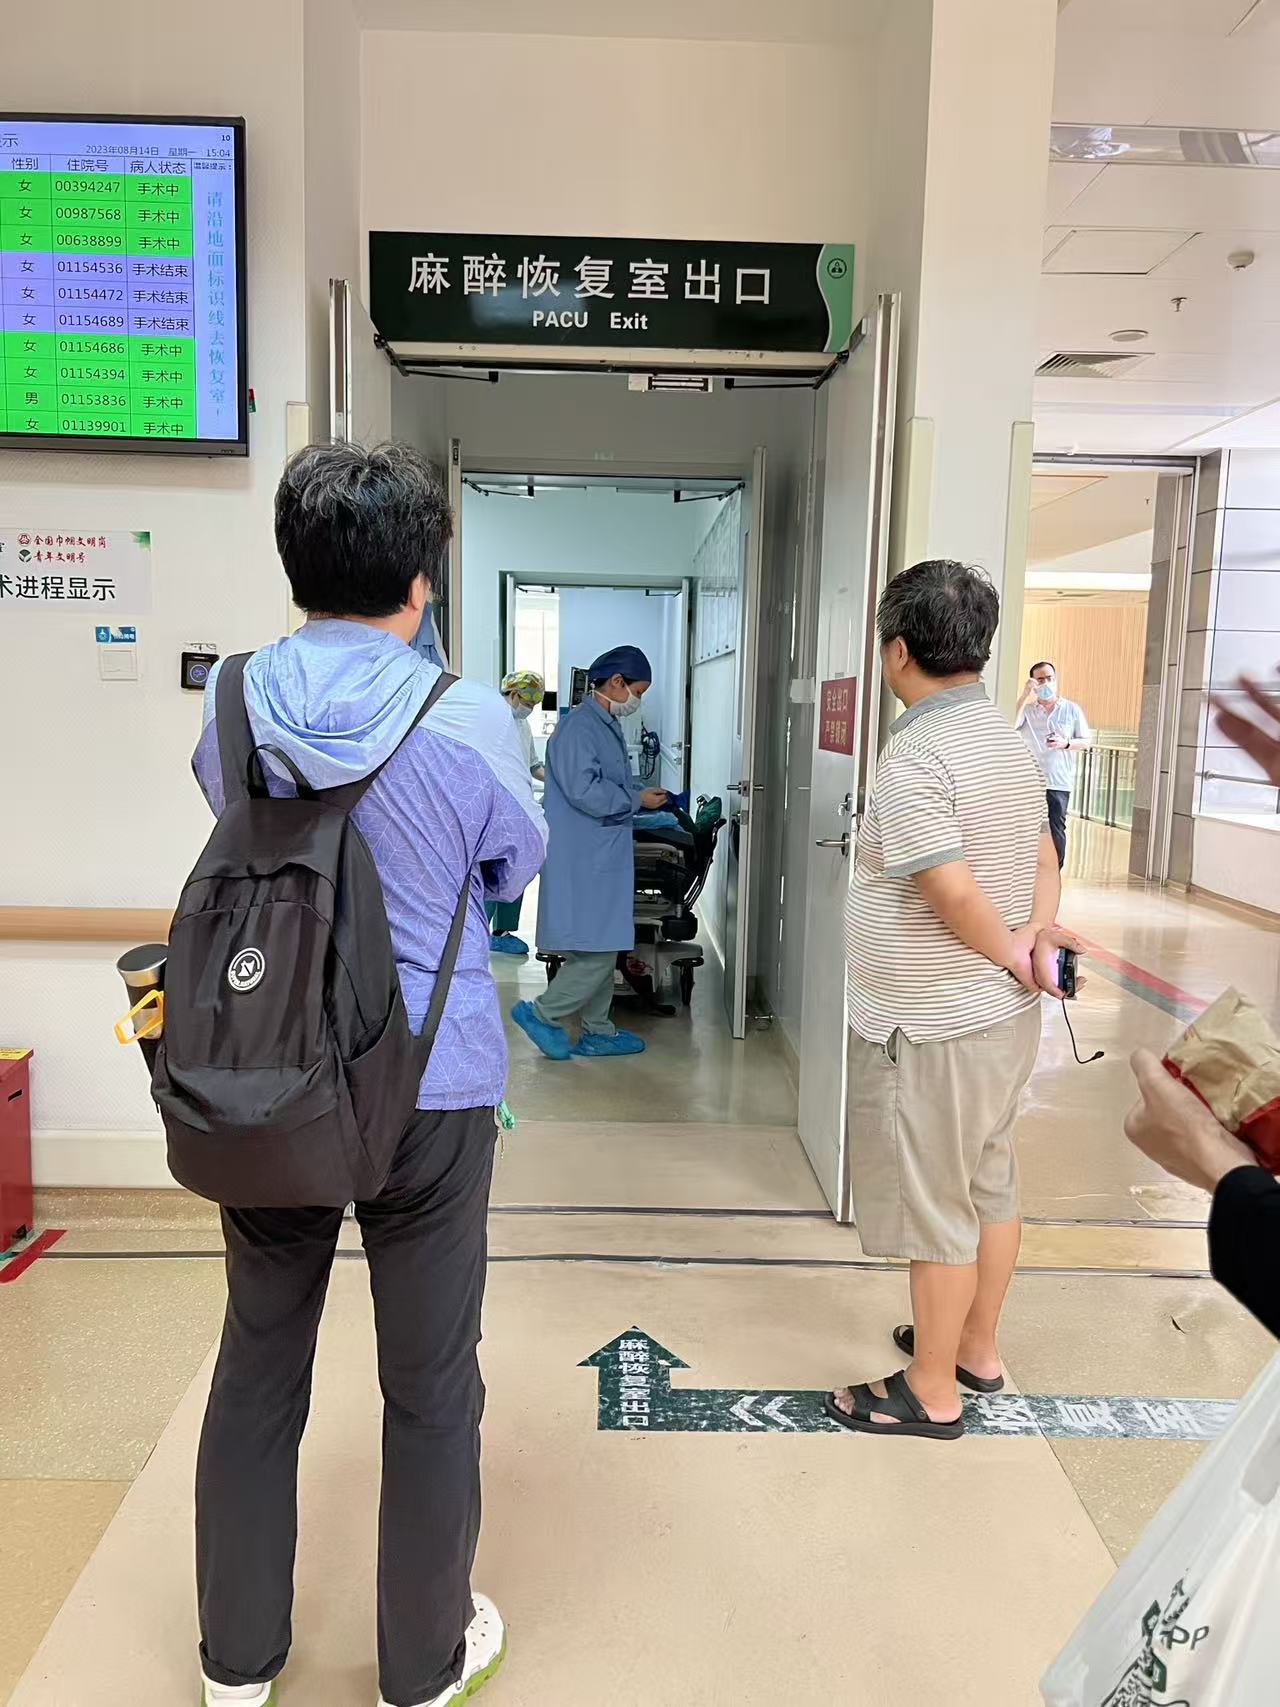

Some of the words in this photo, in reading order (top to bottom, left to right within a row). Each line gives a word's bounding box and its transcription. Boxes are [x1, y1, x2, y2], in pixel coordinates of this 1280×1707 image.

[0, 133, 19, 148] 示
[221, 134, 231, 142] 10
[86, 146, 158, 156] 2023年08月14日
[206, 148, 230, 157] 15:04
[12, 157, 39, 170] 性别
[67, 159, 108, 172] 住院号
[130, 160, 186, 174] 病人状态
[18, 179, 32, 192] 女
[55, 180, 120, 192] 00394247
[138, 183, 179, 196] 手术中
[19, 206, 32, 218] 女
[56, 208, 121, 220] 00987568
[138, 209, 179, 223] 手术中
[20, 233, 33, 245] 女
[57, 234, 121, 247] 00638899
[139, 237, 180, 250] 手术中
[21, 260, 34, 272] 女
[58, 261, 122, 274] 01154536
[132, 264, 188, 277] 手术结束
[408, 252, 772, 304] 麻醉恢复室出口
[22, 287, 35, 299] 女
[58, 288, 123, 301] 01154472
[133, 290, 188, 304] 手术结束
[22, 313, 36, 326] 女
[59, 315, 124, 327] 01154689
[134, 317, 189, 331] 手术结束
[532, 309, 588, 329] PACU
[610, 311, 649, 330] Exit
[24, 340, 37, 352] 女
[60, 341, 124, 353] 01154686
[141, 344, 182, 357] 手术中
[24, 366, 37, 378] 女
[61, 368, 125, 379] 01154394
[142, 370, 182, 383] 手术中
[25, 392, 38, 405] 男
[61, 394, 126, 406] 01153836
[143, 396, 183, 409] 手术中
[26, 419, 38, 431] 女
[62, 420, 125, 432] 01139901
[144, 422, 184, 435] 手术中
[34, 550, 86, 563] 青年文明号
[618, 1339, 651, 1427] 麻醉恢复室出口
